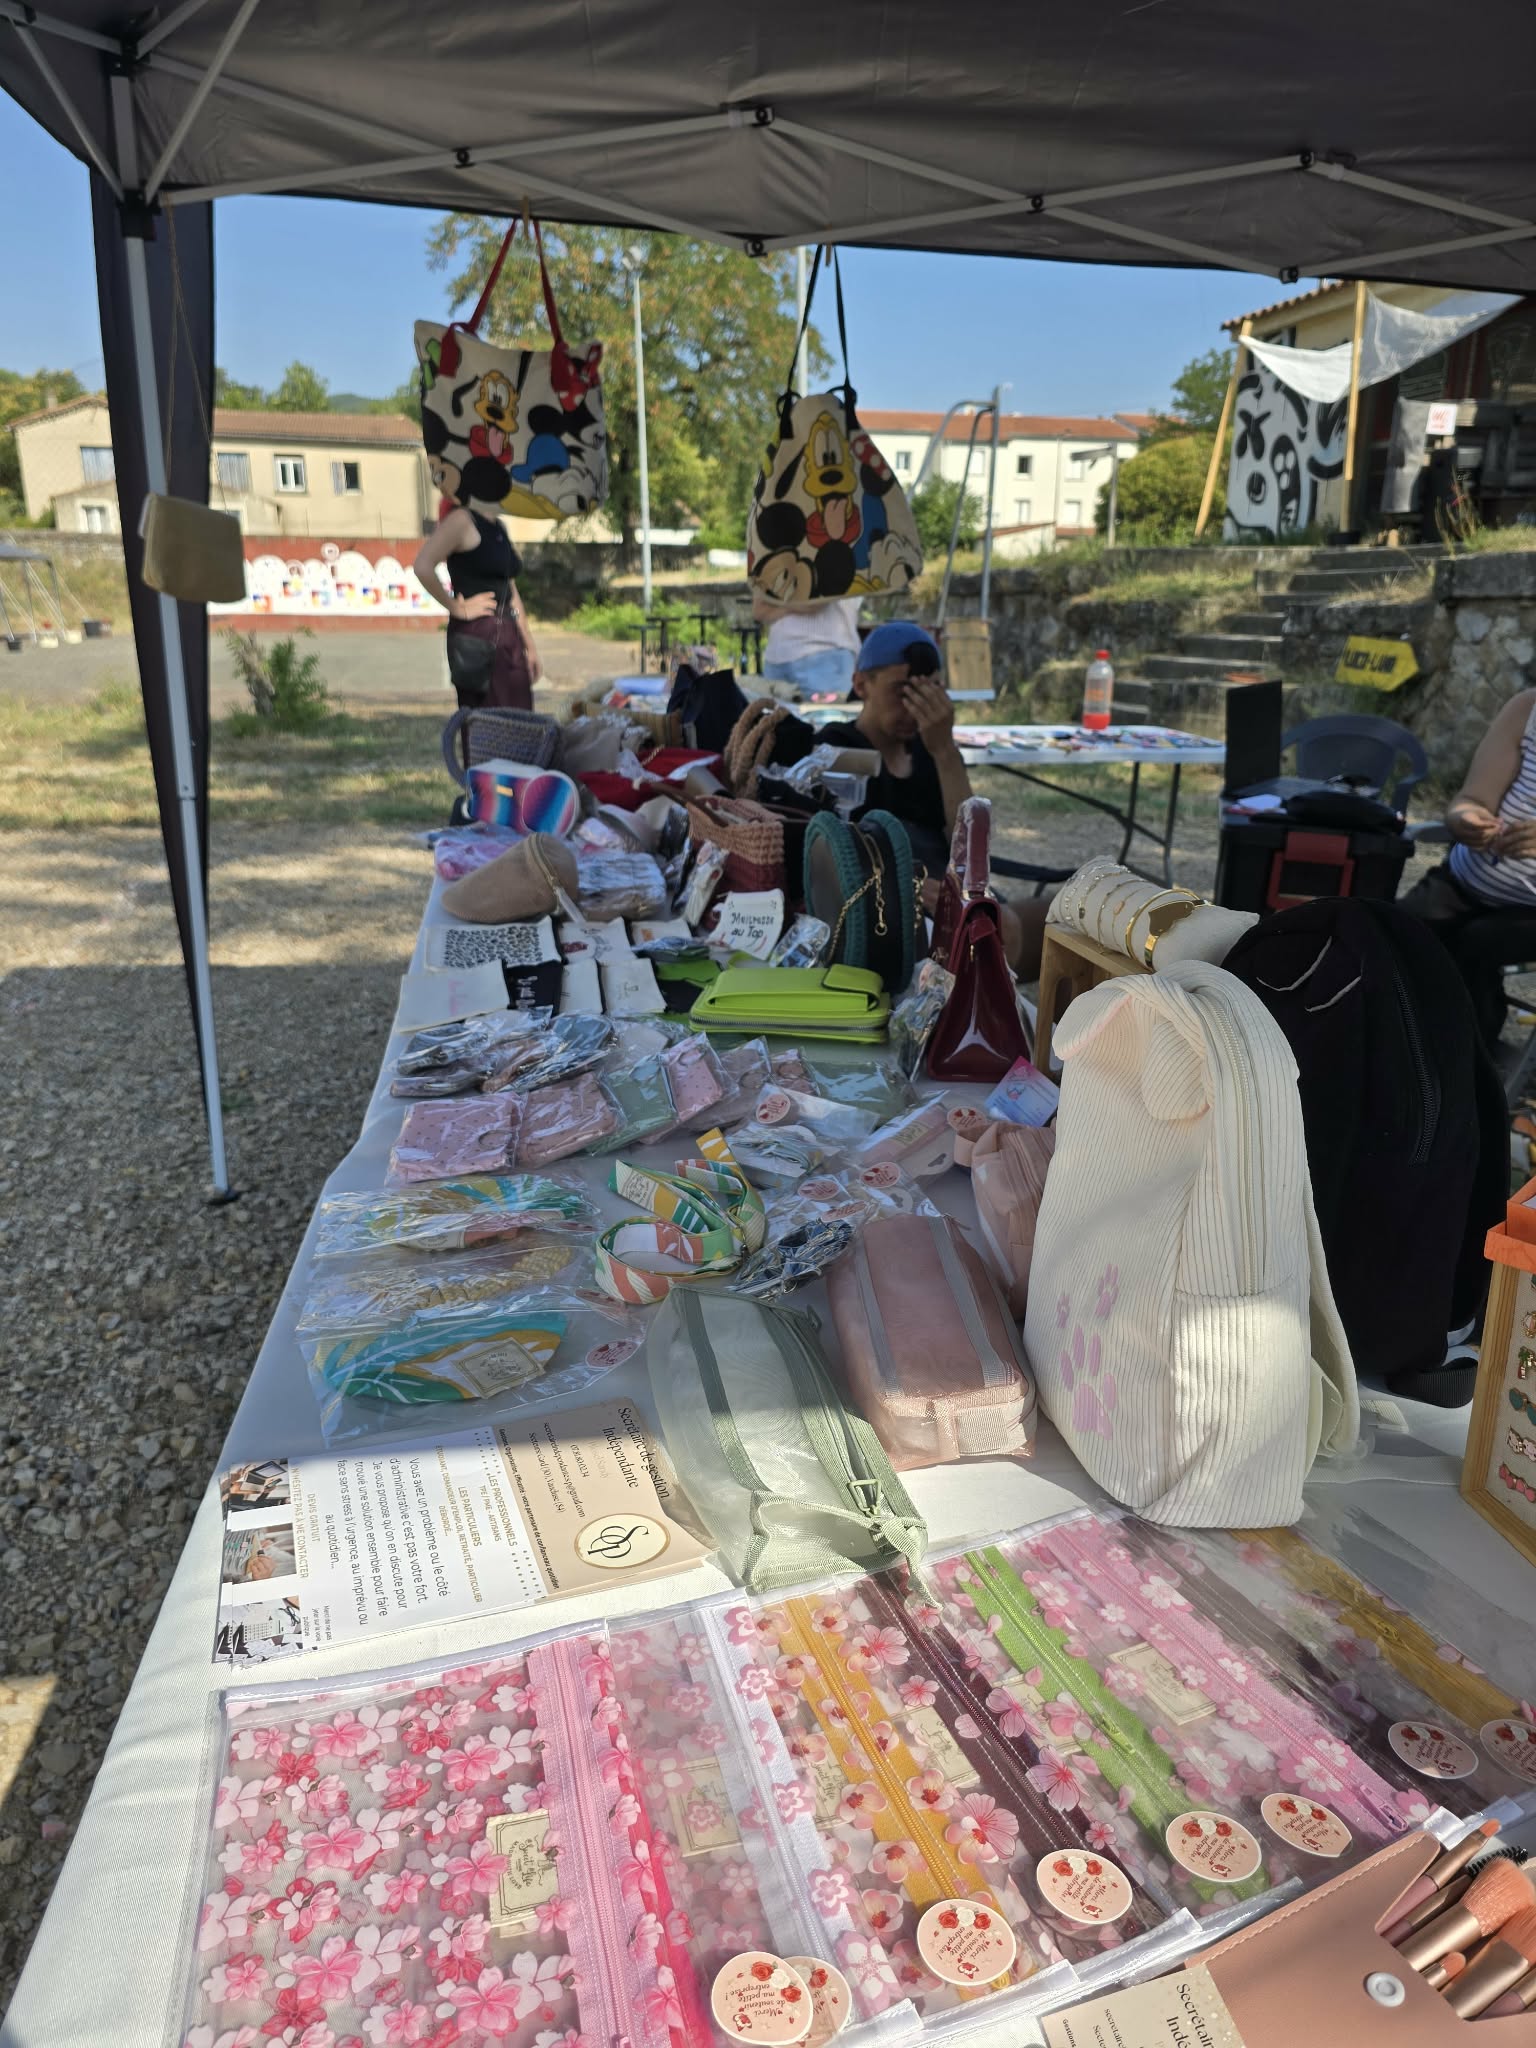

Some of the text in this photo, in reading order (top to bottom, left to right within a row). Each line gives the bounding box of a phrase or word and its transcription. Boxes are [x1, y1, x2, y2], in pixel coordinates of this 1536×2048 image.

[731, 926, 764, 938] au Top
[604, 1428, 638, 1487] Indépendante
[618, 1408, 669, 1498] Secrétaire de gestion
[337, 1459, 347, 1475] face
[292, 1468, 302, 1501] N'HÉSITEZ
[339, 1476, 349, 1493] sans
[294, 1502, 303, 1516] PAS
[342, 1494, 352, 1515] stress
[479, 1485, 487, 1495] TPE
[483, 1498, 492, 1509] PME
[488, 1514, 501, 1541] ARTISANS
[488, 1475, 517, 1546] LES PROFESSIONNELS
[307, 1493, 320, 1541] DEVIS GRATUIT
[457, 1486, 481, 1546] LES PARTICULIERS
[296, 1523, 304, 1534] ME
[372, 1461, 407, 1608] Je vous propose qu'on en discute pour
[390, 1458, 428, 1603] d'administrative c'est pas votre fort.
[409, 1458, 450, 1596] Vous avez un problème ou le côté
[442, 1473, 456, 1504] DEMANDEUR
[458, 1533, 472, 1564] RETRAITÉ,
[466, 1564, 482, 1602] PARTICULIER
[325, 1514, 340, 1568] au quotidien...
[344, 1522, 358, 1561] l'urgence,
[354, 1461, 388, 1616] trouvé une solution ensemble pour faire
[297, 1535, 308, 1578] CONTACTER
[351, 1563, 360, 1574] au
[352, 1575, 367, 1612] imprévu
[358, 1613, 368, 1625] ou
[1220, 1846, 1234, 1861] Merci
[1092, 1886, 1106, 1902] Merci
[950, 1936, 965, 1955] petite
[960, 1937, 979, 1958] soutenir
[971, 1942, 988, 1959] Merci
[730, 1984, 770, 1996] entreprise
[739, 1992, 760, 2002] petite
[744, 2000, 785, 2009] de soutenir
[754, 2008, 777, 2017] Merci
